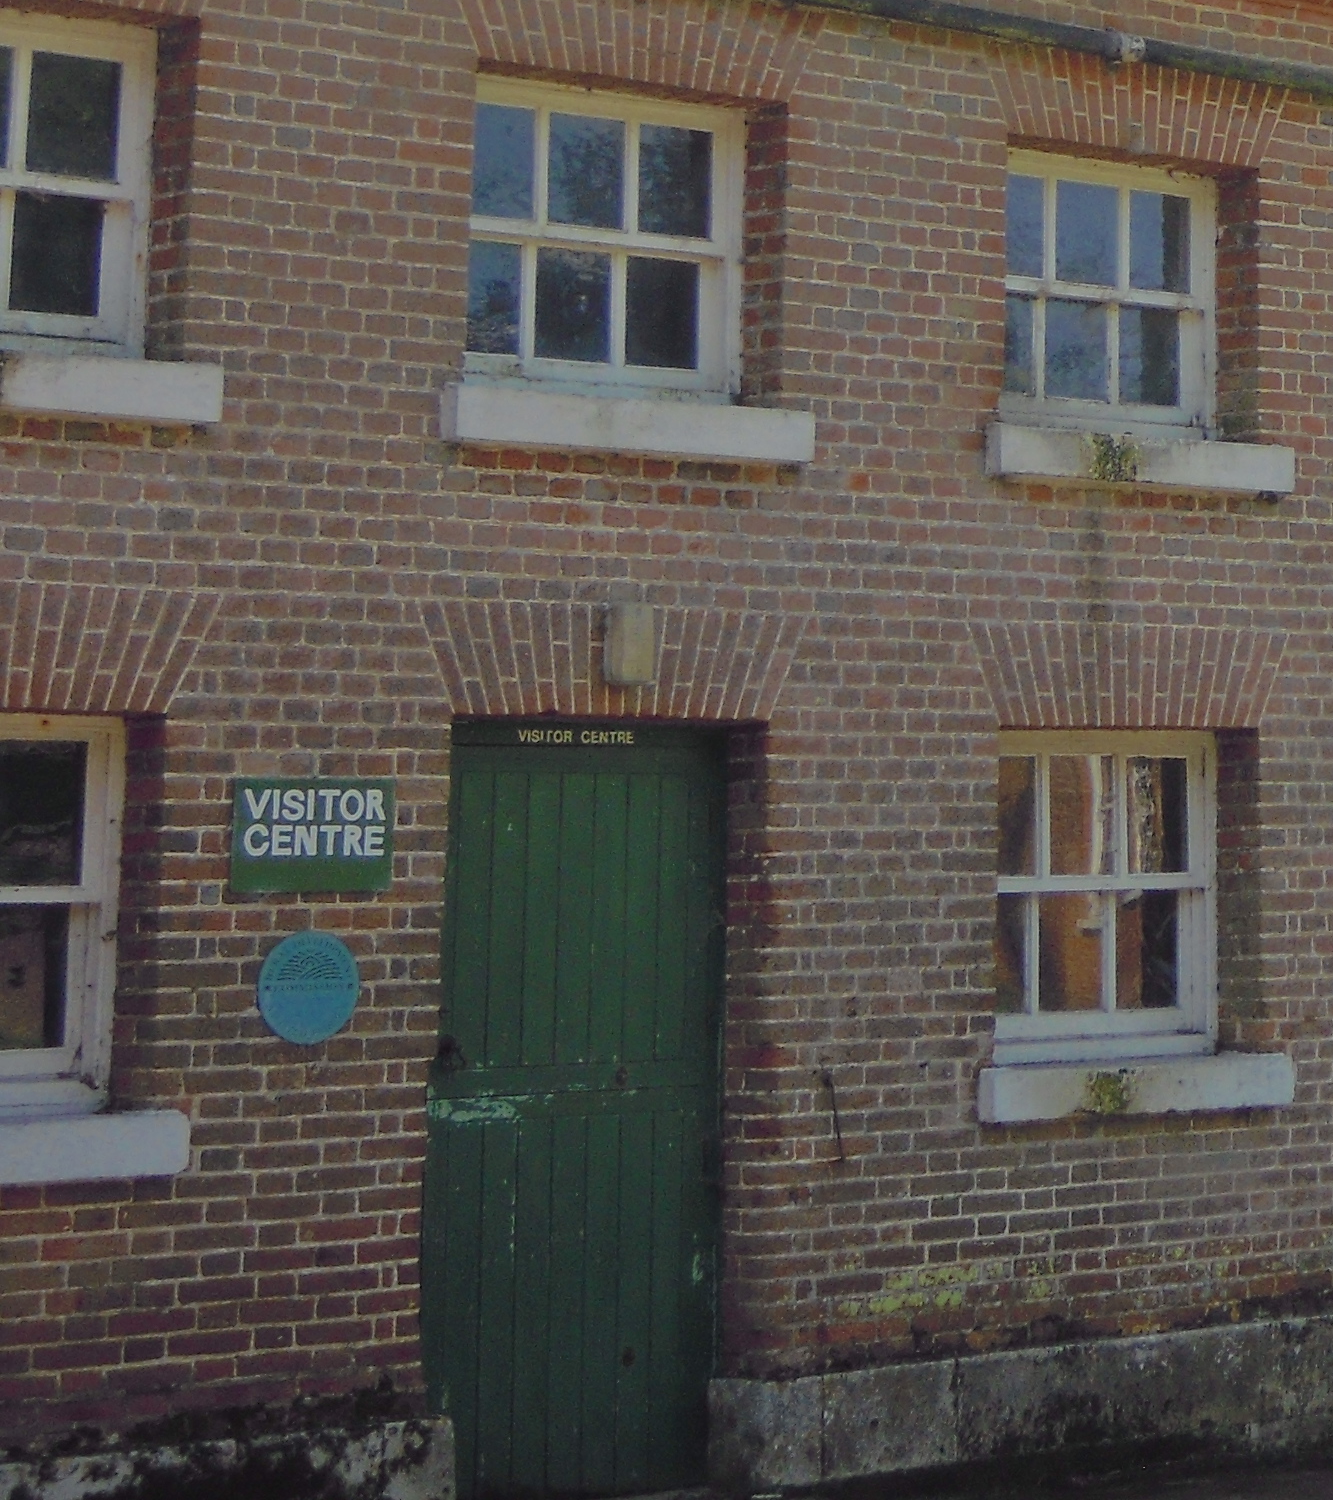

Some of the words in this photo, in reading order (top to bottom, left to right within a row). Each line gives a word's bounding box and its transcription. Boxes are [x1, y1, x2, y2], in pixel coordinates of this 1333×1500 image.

[518, 729, 573, 743] VISITOR
[580, 730, 635, 745] CENTRE
[244, 788, 386, 821] VISITOR
[243, 823, 386, 857] CENTRE
